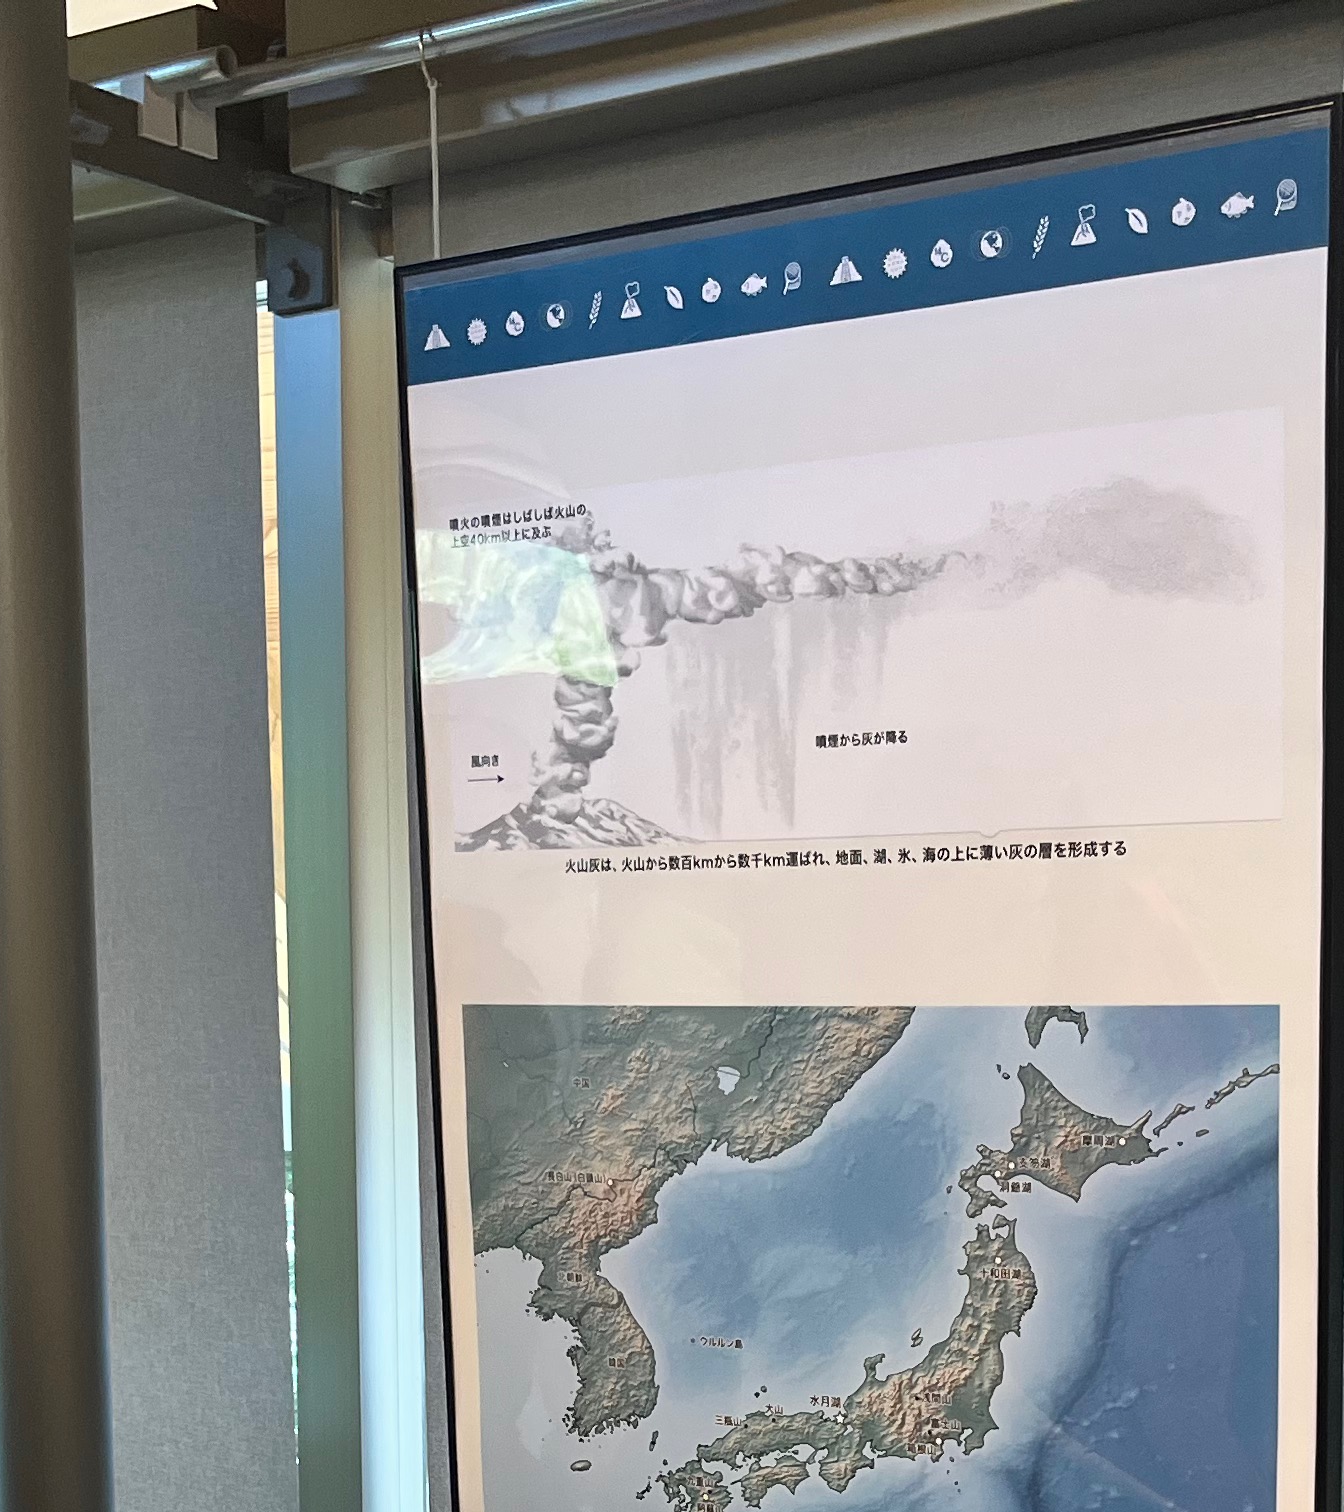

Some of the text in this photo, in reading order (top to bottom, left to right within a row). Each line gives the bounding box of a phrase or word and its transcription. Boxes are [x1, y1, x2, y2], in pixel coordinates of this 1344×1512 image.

[815, 731, 908, 749] 噴煙から灰が降る
[809, 1395, 842, 1408] 水月湖
